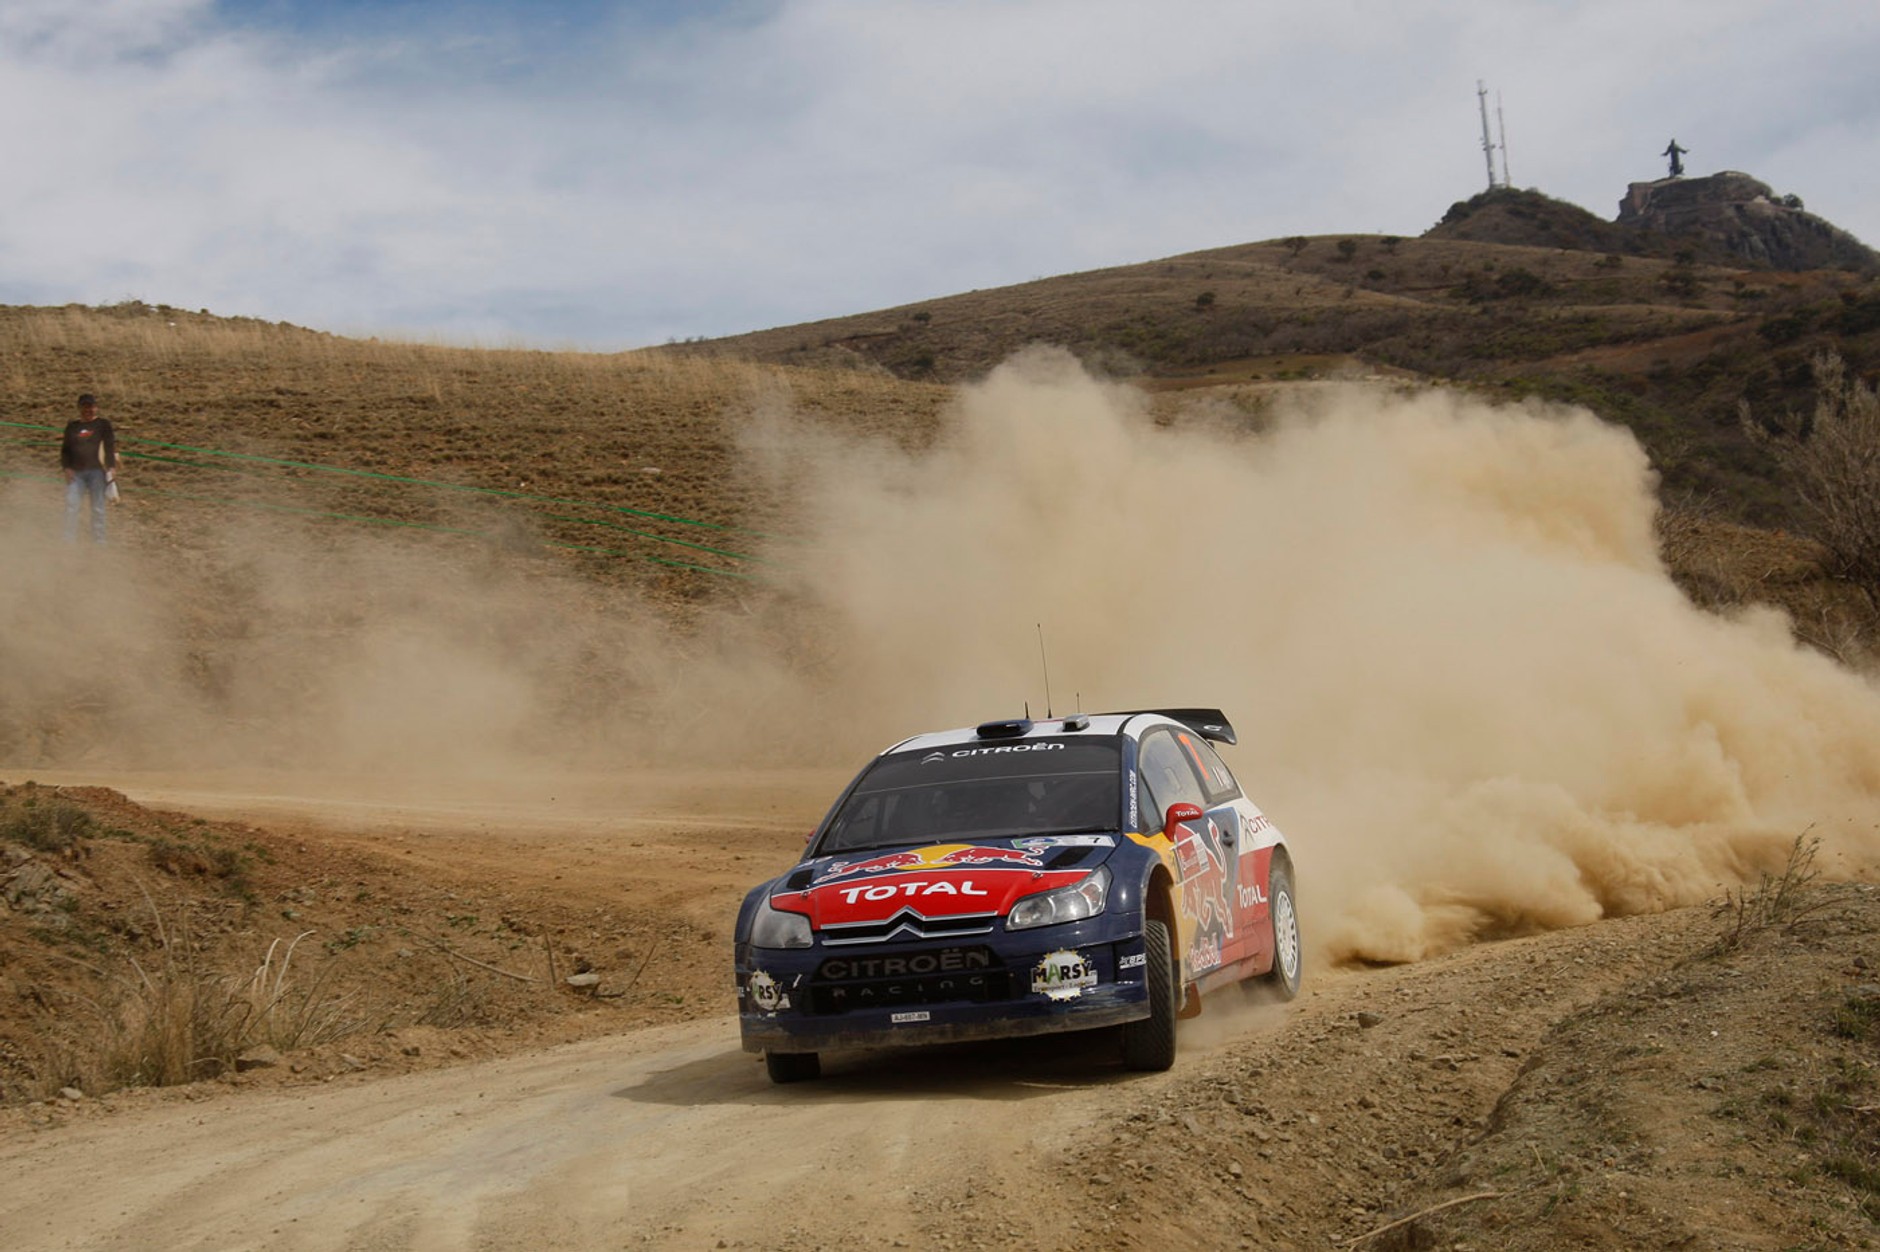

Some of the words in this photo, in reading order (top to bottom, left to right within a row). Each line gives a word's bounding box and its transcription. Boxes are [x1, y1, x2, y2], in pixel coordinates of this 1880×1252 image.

[1175, 808, 1200, 817] TOTAL
[840, 881, 988, 904] TOTAL
[1237, 884, 1268, 909] TOTAL
[821, 948, 990, 979] CITROËN
[1033, 960, 1093, 984] MARSY
[832, 976, 984, 998] RACING
